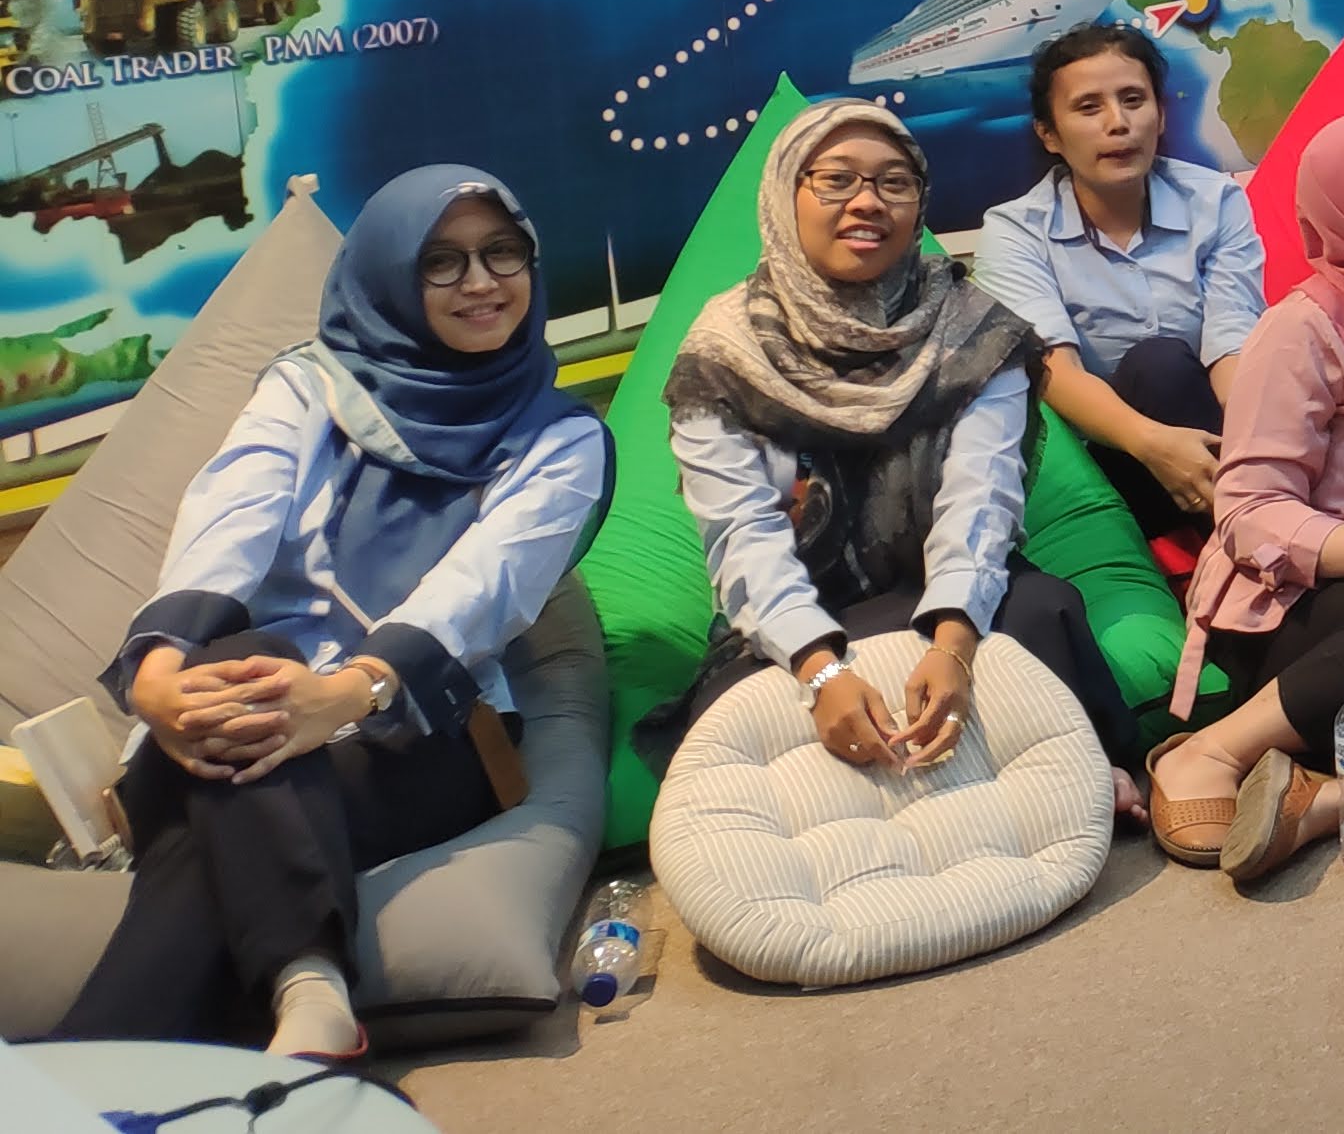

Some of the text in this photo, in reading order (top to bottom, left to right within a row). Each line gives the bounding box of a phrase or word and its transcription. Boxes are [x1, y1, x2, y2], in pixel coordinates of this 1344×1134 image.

[6, 63, 99, 96] COAL
[108, 46, 237, 83] TRADER
[265, 27, 343, 62] PMM
[353, 18, 439, 51] (2007)
